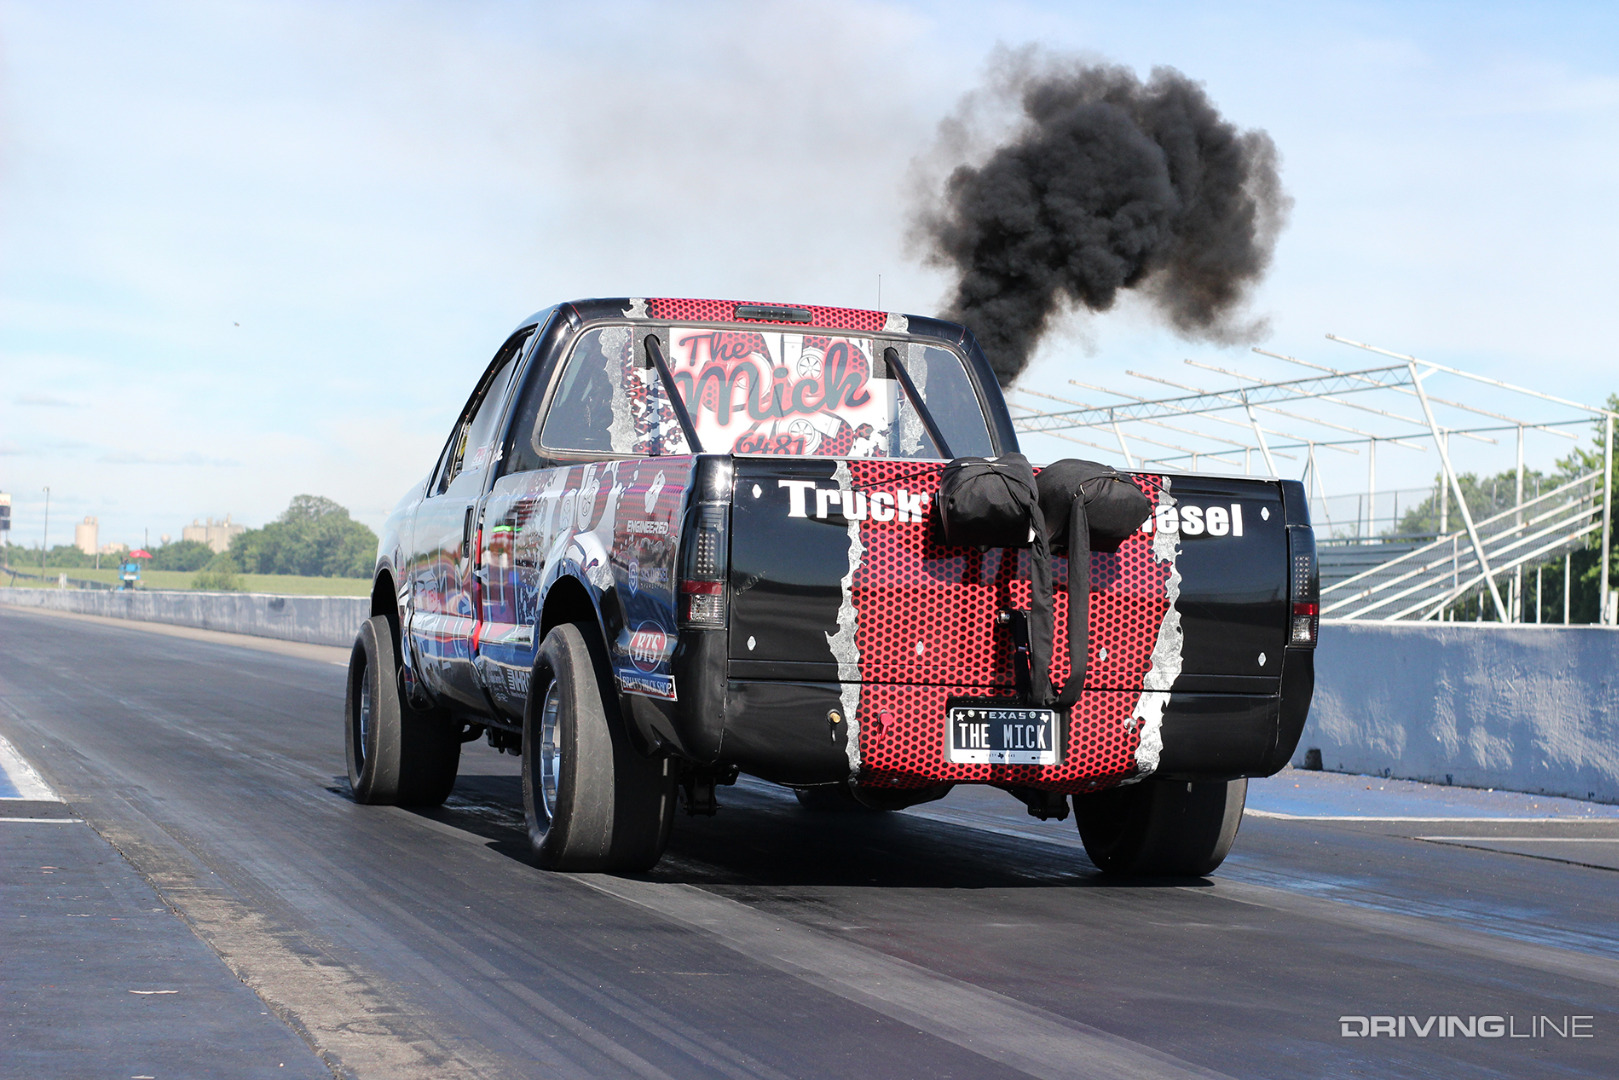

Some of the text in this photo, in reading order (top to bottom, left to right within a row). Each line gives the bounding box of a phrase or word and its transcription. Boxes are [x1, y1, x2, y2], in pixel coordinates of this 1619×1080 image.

[678, 331, 752, 368] The
[671, 342, 871, 426] Mick
[777, 479, 923, 523] Truck
[626, 520, 669, 535] ENGINEERED
[634, 632, 661, 664] BTS
[657, 681, 672, 695] SHOP
[979, 711, 1027, 720] TEXAS
[958, 723, 1047, 749] THE MICK
